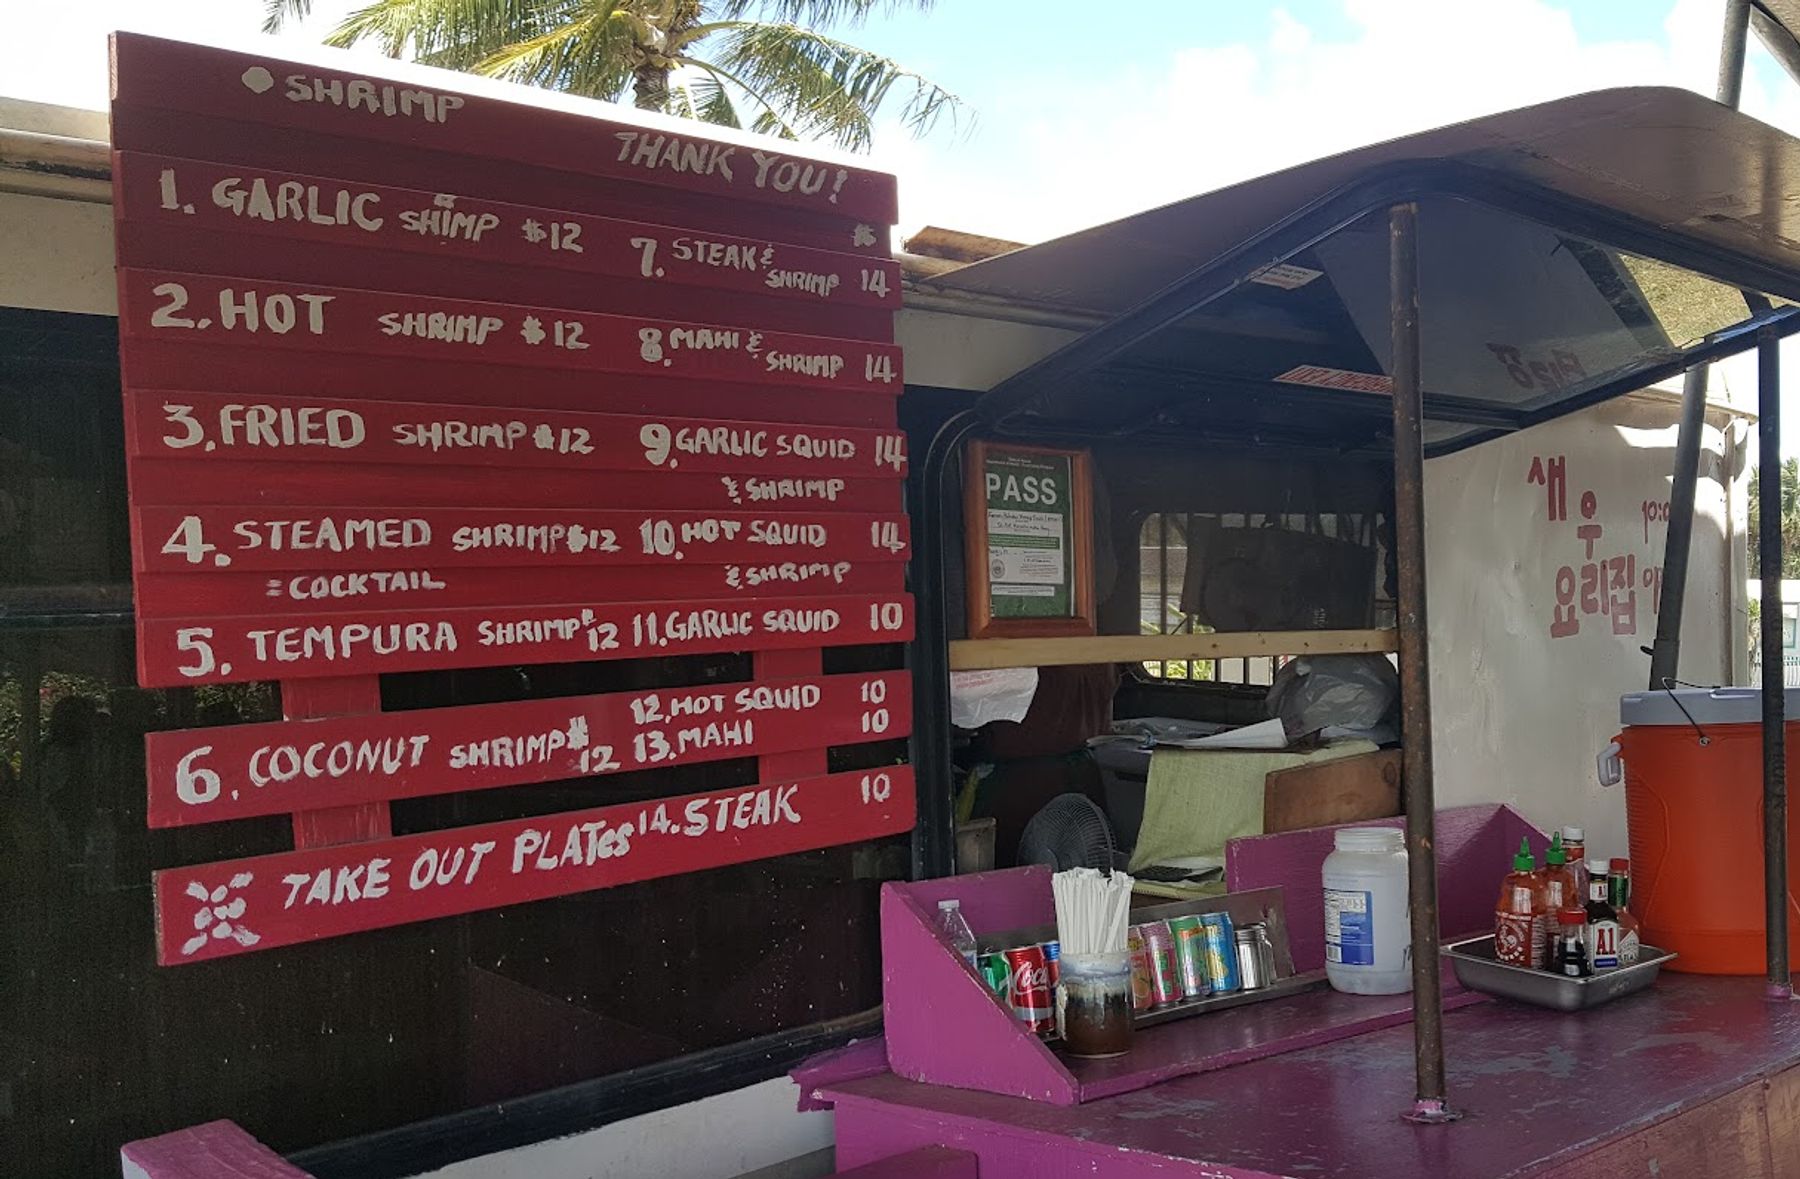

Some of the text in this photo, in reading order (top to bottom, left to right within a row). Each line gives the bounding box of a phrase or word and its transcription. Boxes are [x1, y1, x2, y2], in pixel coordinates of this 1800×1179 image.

[285, 75, 465, 123] SHRIMP
[614, 131, 848, 203] THANK YOU!
[212, 178, 384, 231] GARLIC
[672, 238, 757, 271] STEAK
[765, 269, 891, 298] SHRIMP 14
[219, 288, 336, 334] HOT
[377, 312, 504, 345] SHRIMP
[670, 327, 739, 350] MAHI
[766, 351, 897, 384] SHRIMP 14
[219, 403, 366, 449] FRIED
[392, 420, 528, 452] SHRIMP
[675, 426, 768, 460] GARLIC
[776, 434, 856, 459] SQUID
[875, 436, 908, 472] 14
[745, 478, 845, 502] SHRIMP
[985, 472, 1058, 505] PASS
[232, 517, 432, 552] STEAMED
[451, 522, 567, 555] SHRIMP
[681, 520, 742, 546] HOT
[746, 520, 828, 548] SQUID
[871, 521, 906, 554] 14
[288, 570, 447, 600] COCKTAIL
[744, 561, 853, 586] SHRIMP
[246, 621, 459, 663] TEMPURA
[477, 618, 582, 648] SHRIMP
[666, 609, 754, 645] GARLIC
[762, 608, 841, 634] SQUID
[869, 602, 904, 632] 10
[670, 694, 727, 718] HOT
[734, 683, 822, 714] SQUID
[859, 679, 888, 704] 10
[677, 719, 755, 756] MAHI
[860, 708, 890, 733] 10
[248, 734, 431, 788] COCONUT
[449, 722, 568, 770] SHRIMP
[683, 783, 803, 838] STEAK
[859, 772, 892, 805] 10
[282, 857, 393, 911] TAKE
[408, 840, 497, 892] OUT
